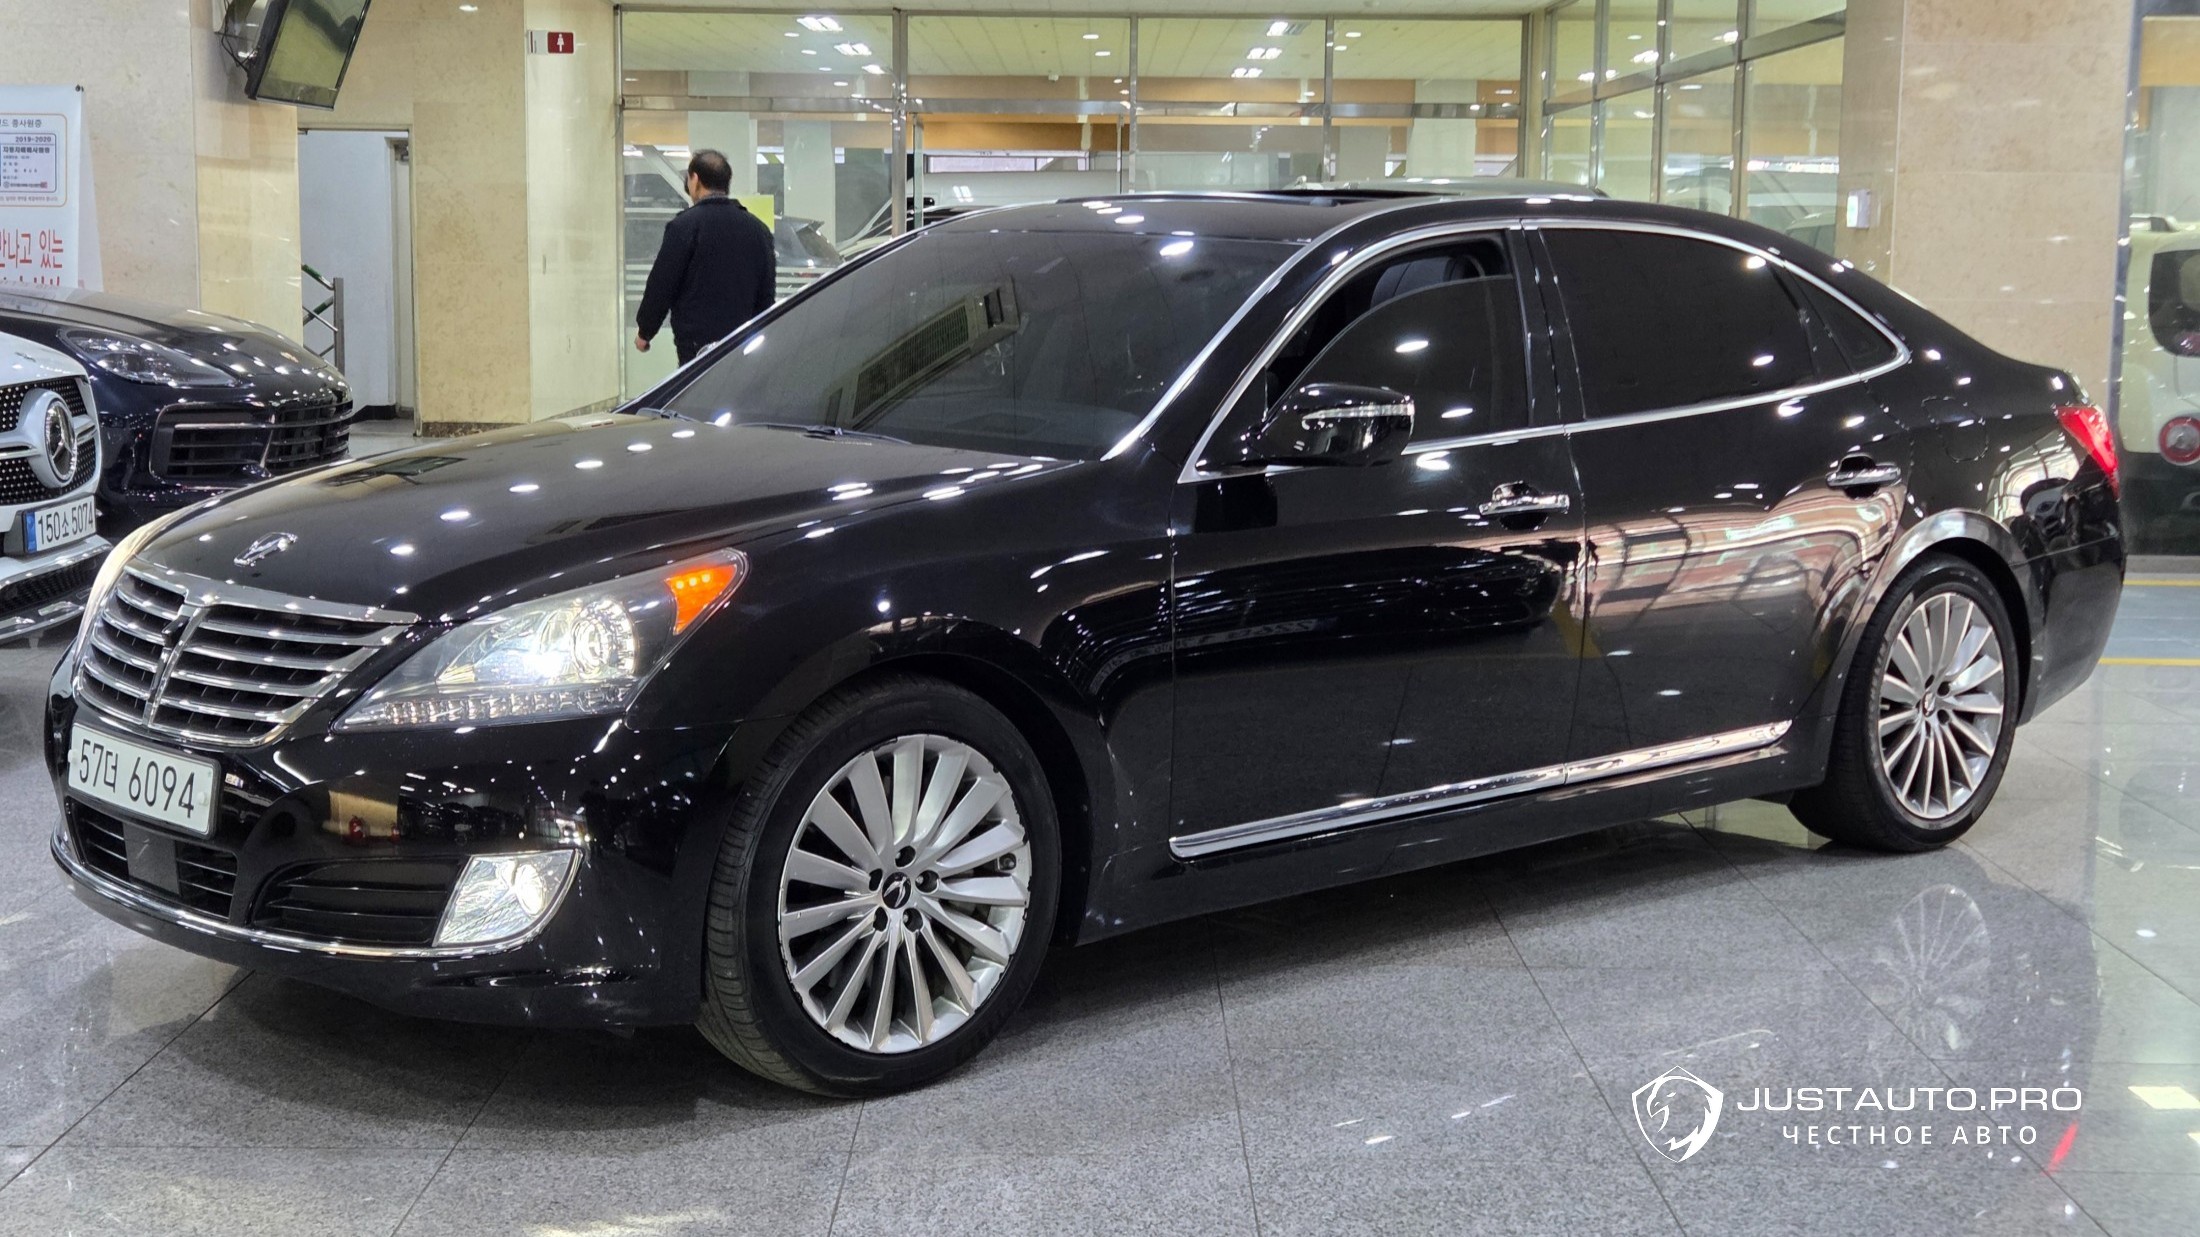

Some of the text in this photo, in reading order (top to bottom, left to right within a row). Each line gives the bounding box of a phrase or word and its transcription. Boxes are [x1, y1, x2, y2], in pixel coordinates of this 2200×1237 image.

[39, 228, 63, 269] 있는
[38, 501, 94, 545] 150소 5074
[79, 738, 195, 819] 57더 6094
